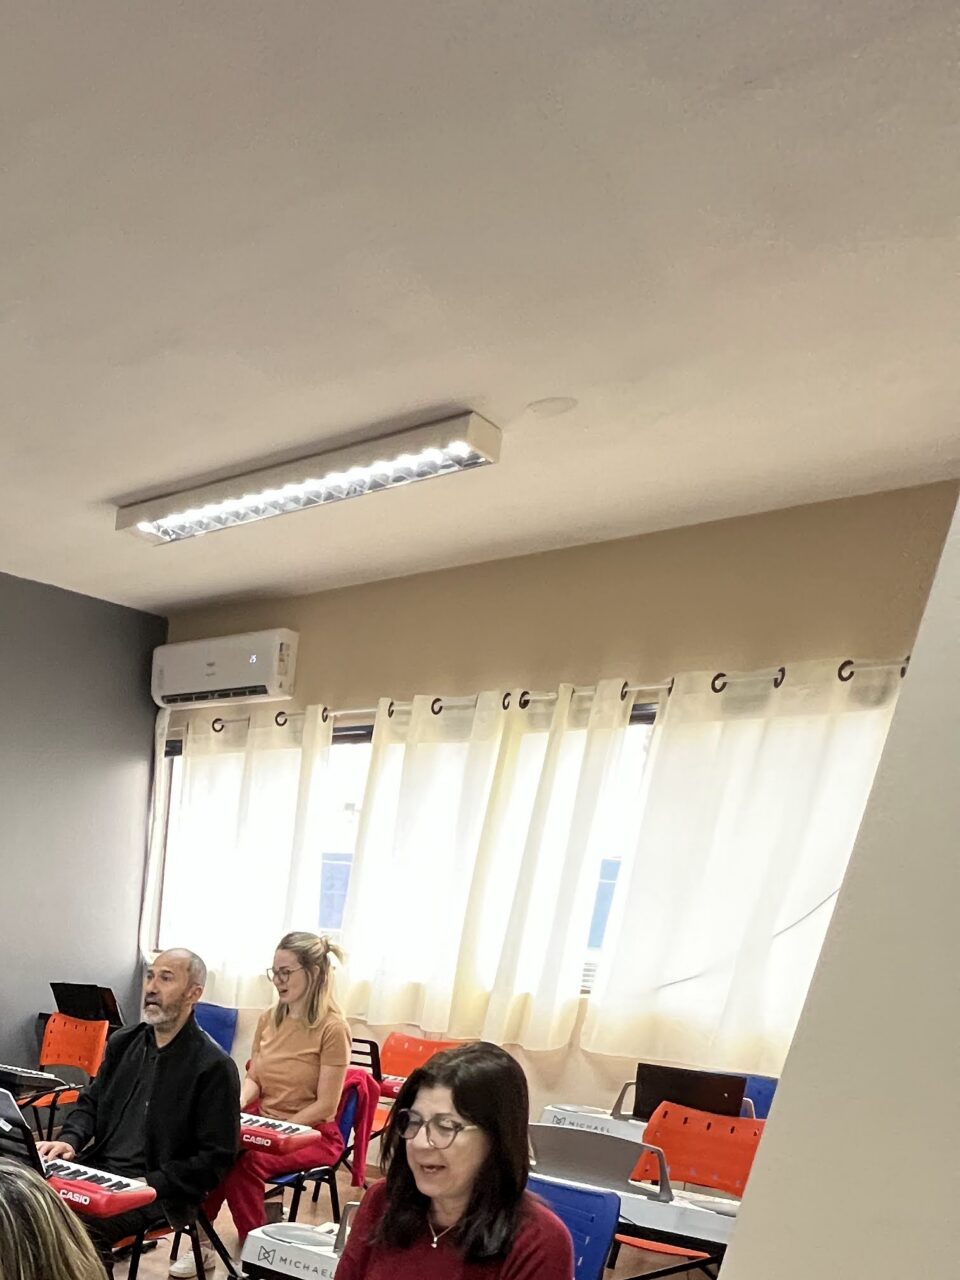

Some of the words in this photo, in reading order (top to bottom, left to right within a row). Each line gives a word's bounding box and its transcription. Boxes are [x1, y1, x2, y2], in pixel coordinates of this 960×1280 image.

[568, 1121, 611, 1133] MICHAEL
[242, 1134, 272, 1147] CASIO
[59, 1189, 91, 1205] CASIO
